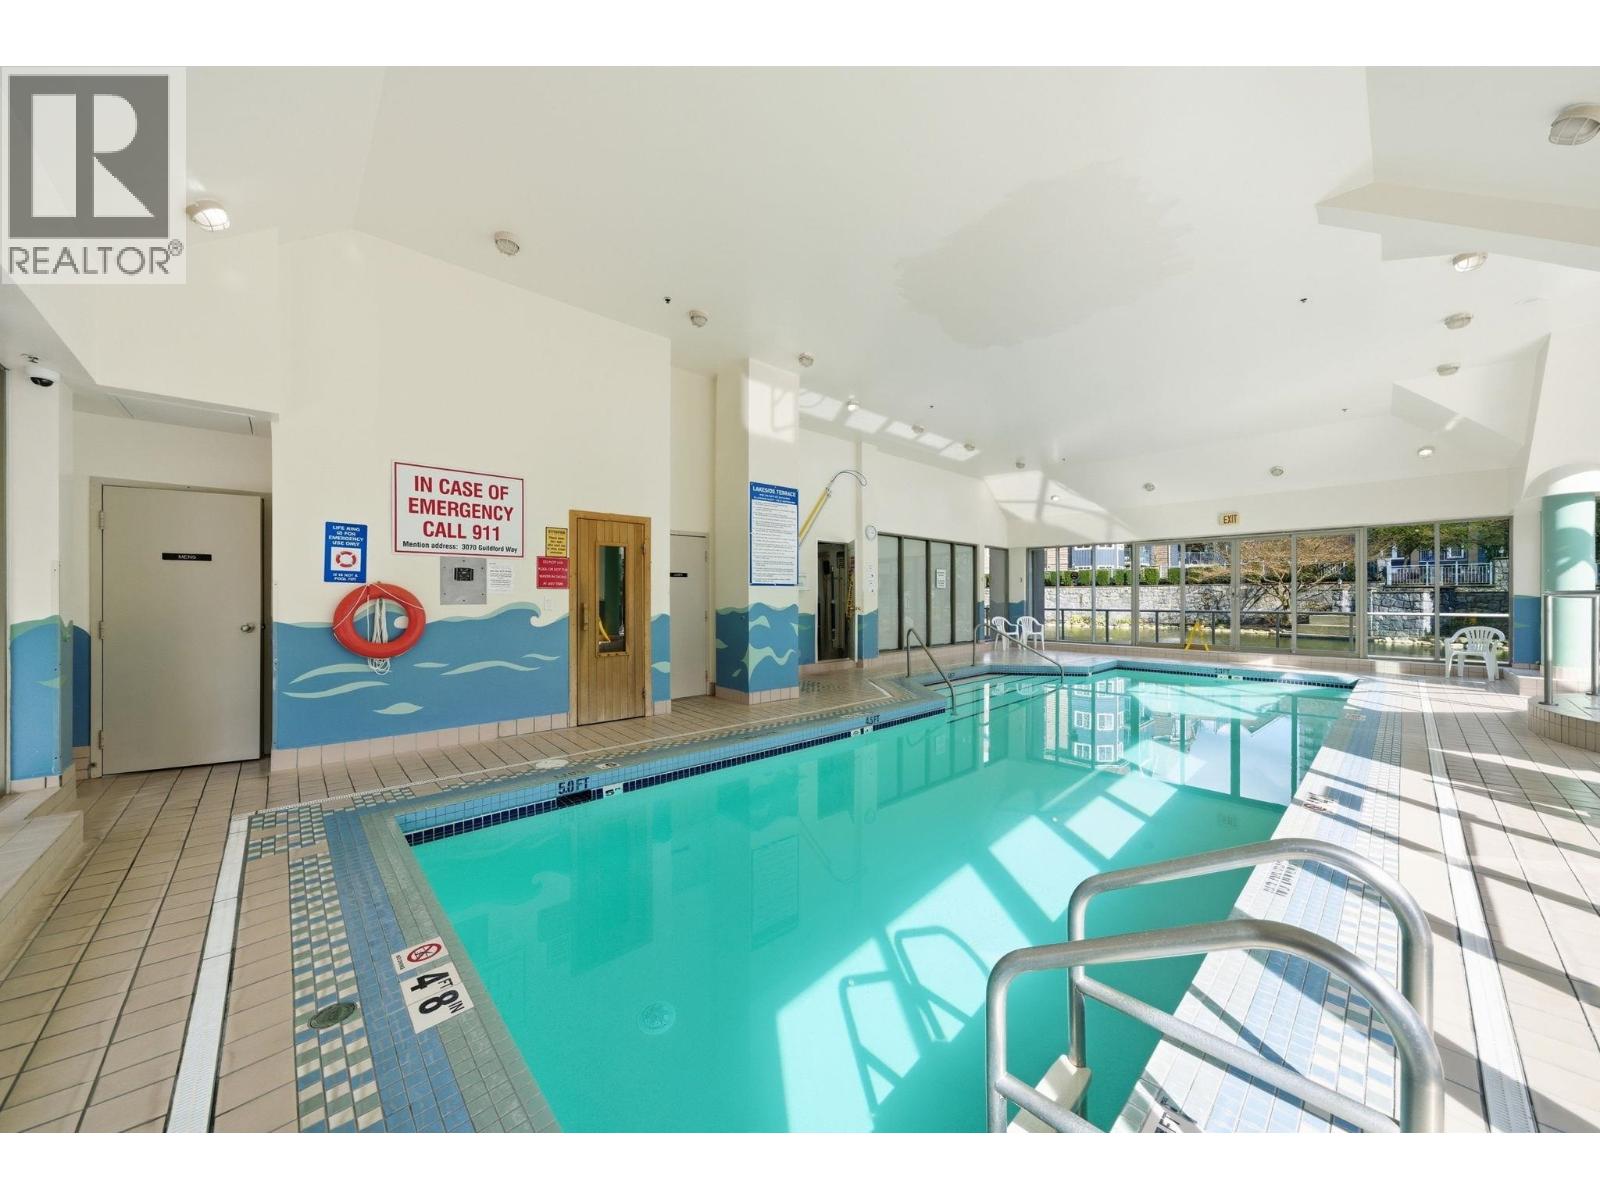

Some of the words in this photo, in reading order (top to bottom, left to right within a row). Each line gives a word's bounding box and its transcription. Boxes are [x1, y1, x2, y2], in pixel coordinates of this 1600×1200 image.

[414, 475, 433, 493] IN
[439, 478, 483, 498] CASE
[488, 484, 509, 500] OF
[752, 486, 775, 494] LAKESIDE
[408, 497, 514, 521] EMERGENCY
[1223, 514, 1238, 524] EXIT
[423, 520, 467, 539] CALL
[472, 524, 500, 541] 911
[402, 540, 430, 549] Mention
[431, 542, 458, 551] address:
[461, 543, 477, 551] 3070
[478, 544, 505, 553] Guildford
[505, 546, 518, 554] Way
[575, 776, 590, 791] FT
[410, 971, 450, 993] 4
[438, 977, 454, 989] FT
[418, 989, 460, 1015] 8
[448, 1000, 465, 1014] IN
